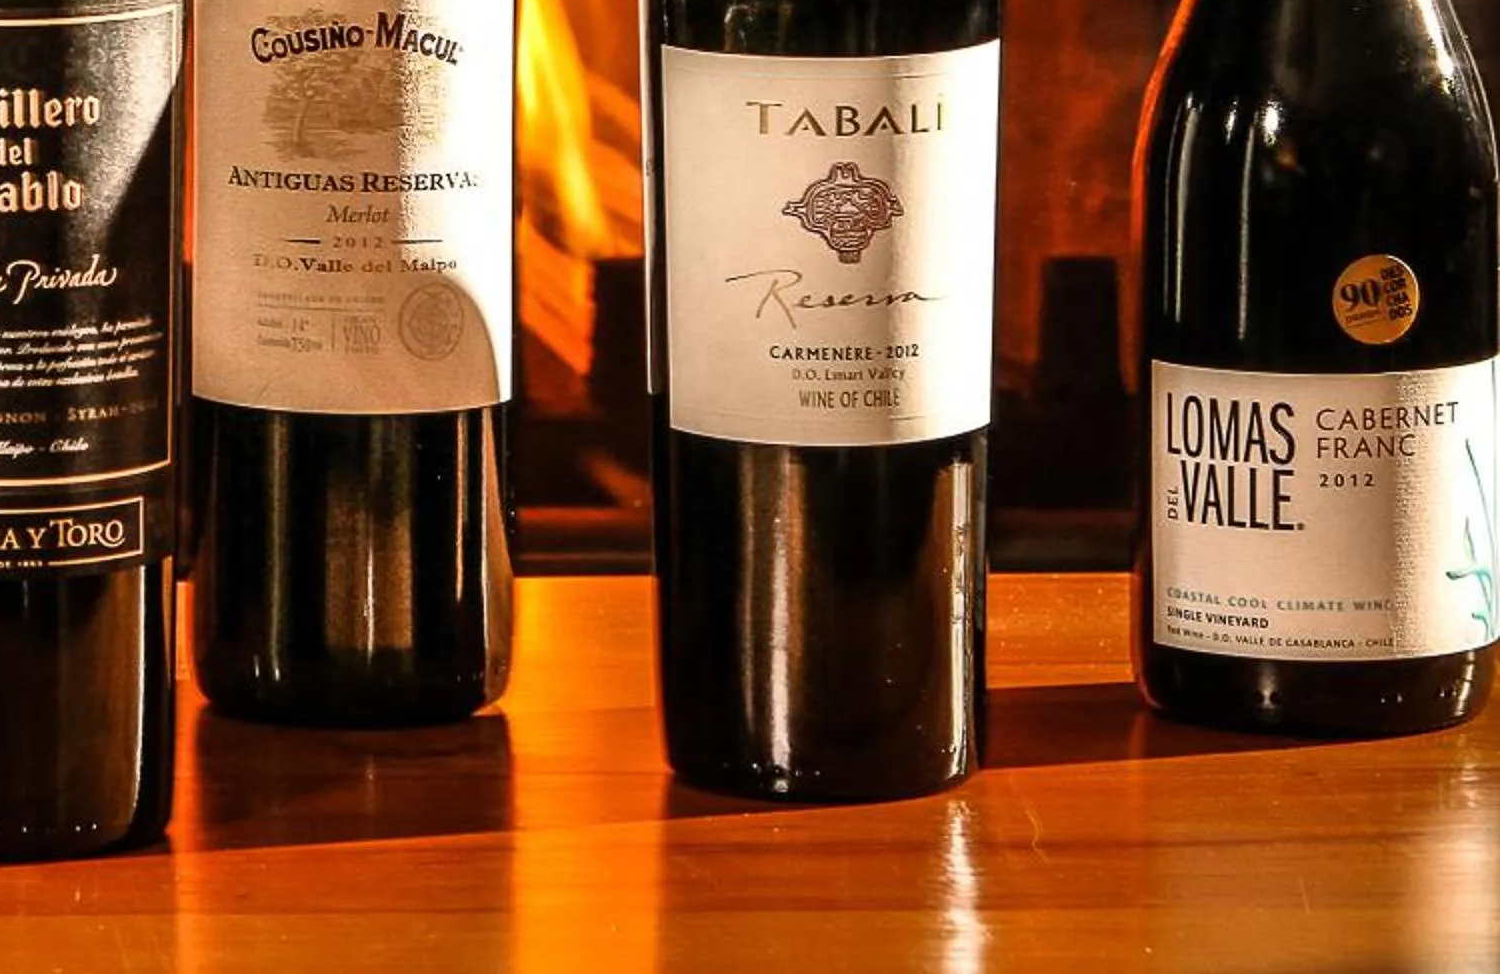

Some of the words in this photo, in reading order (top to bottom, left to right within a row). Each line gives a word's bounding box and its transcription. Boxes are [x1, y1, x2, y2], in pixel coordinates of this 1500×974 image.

[228, 166, 355, 193] ANTIGUAS
[360, 172, 479, 194] RESERVA
[326, 204, 391, 223] Merlot
[332, 237, 384, 249] 2012
[361, 257, 392, 273] del
[401, 258, 457, 275] Maipo
[6, 253, 117, 305] Privada
[1341, 278, 1379, 312] 90
[886, 343, 920, 359] 2012
[799, 390, 835, 409] WINE
[839, 390, 859, 408] OF
[863, 389, 901, 408] CHILE
[1167, 392, 1295, 466] LOMAS
[1315, 402, 1459, 431] CABERNET
[1317, 433, 1416, 459] FRANC
[1319, 473, 1376, 488] 2012
[1167, 486, 1179, 520] DEL
[27, 528, 48, 549] Y
[50, 518, 125, 548] TORO
[1166, 587, 1221, 606] COASTAL
[1227, 596, 1268, 610] COOL
[1277, 600, 1344, 612] CLIMATE
[1166, 606, 1202, 623] SINGLE
[1206, 612, 1269, 629] VINEYARD
[1236, 635, 1265, 646] VALLE
[1269, 637, 1283, 647] DE
[1285, 637, 1355, 648] CASABLANCA
